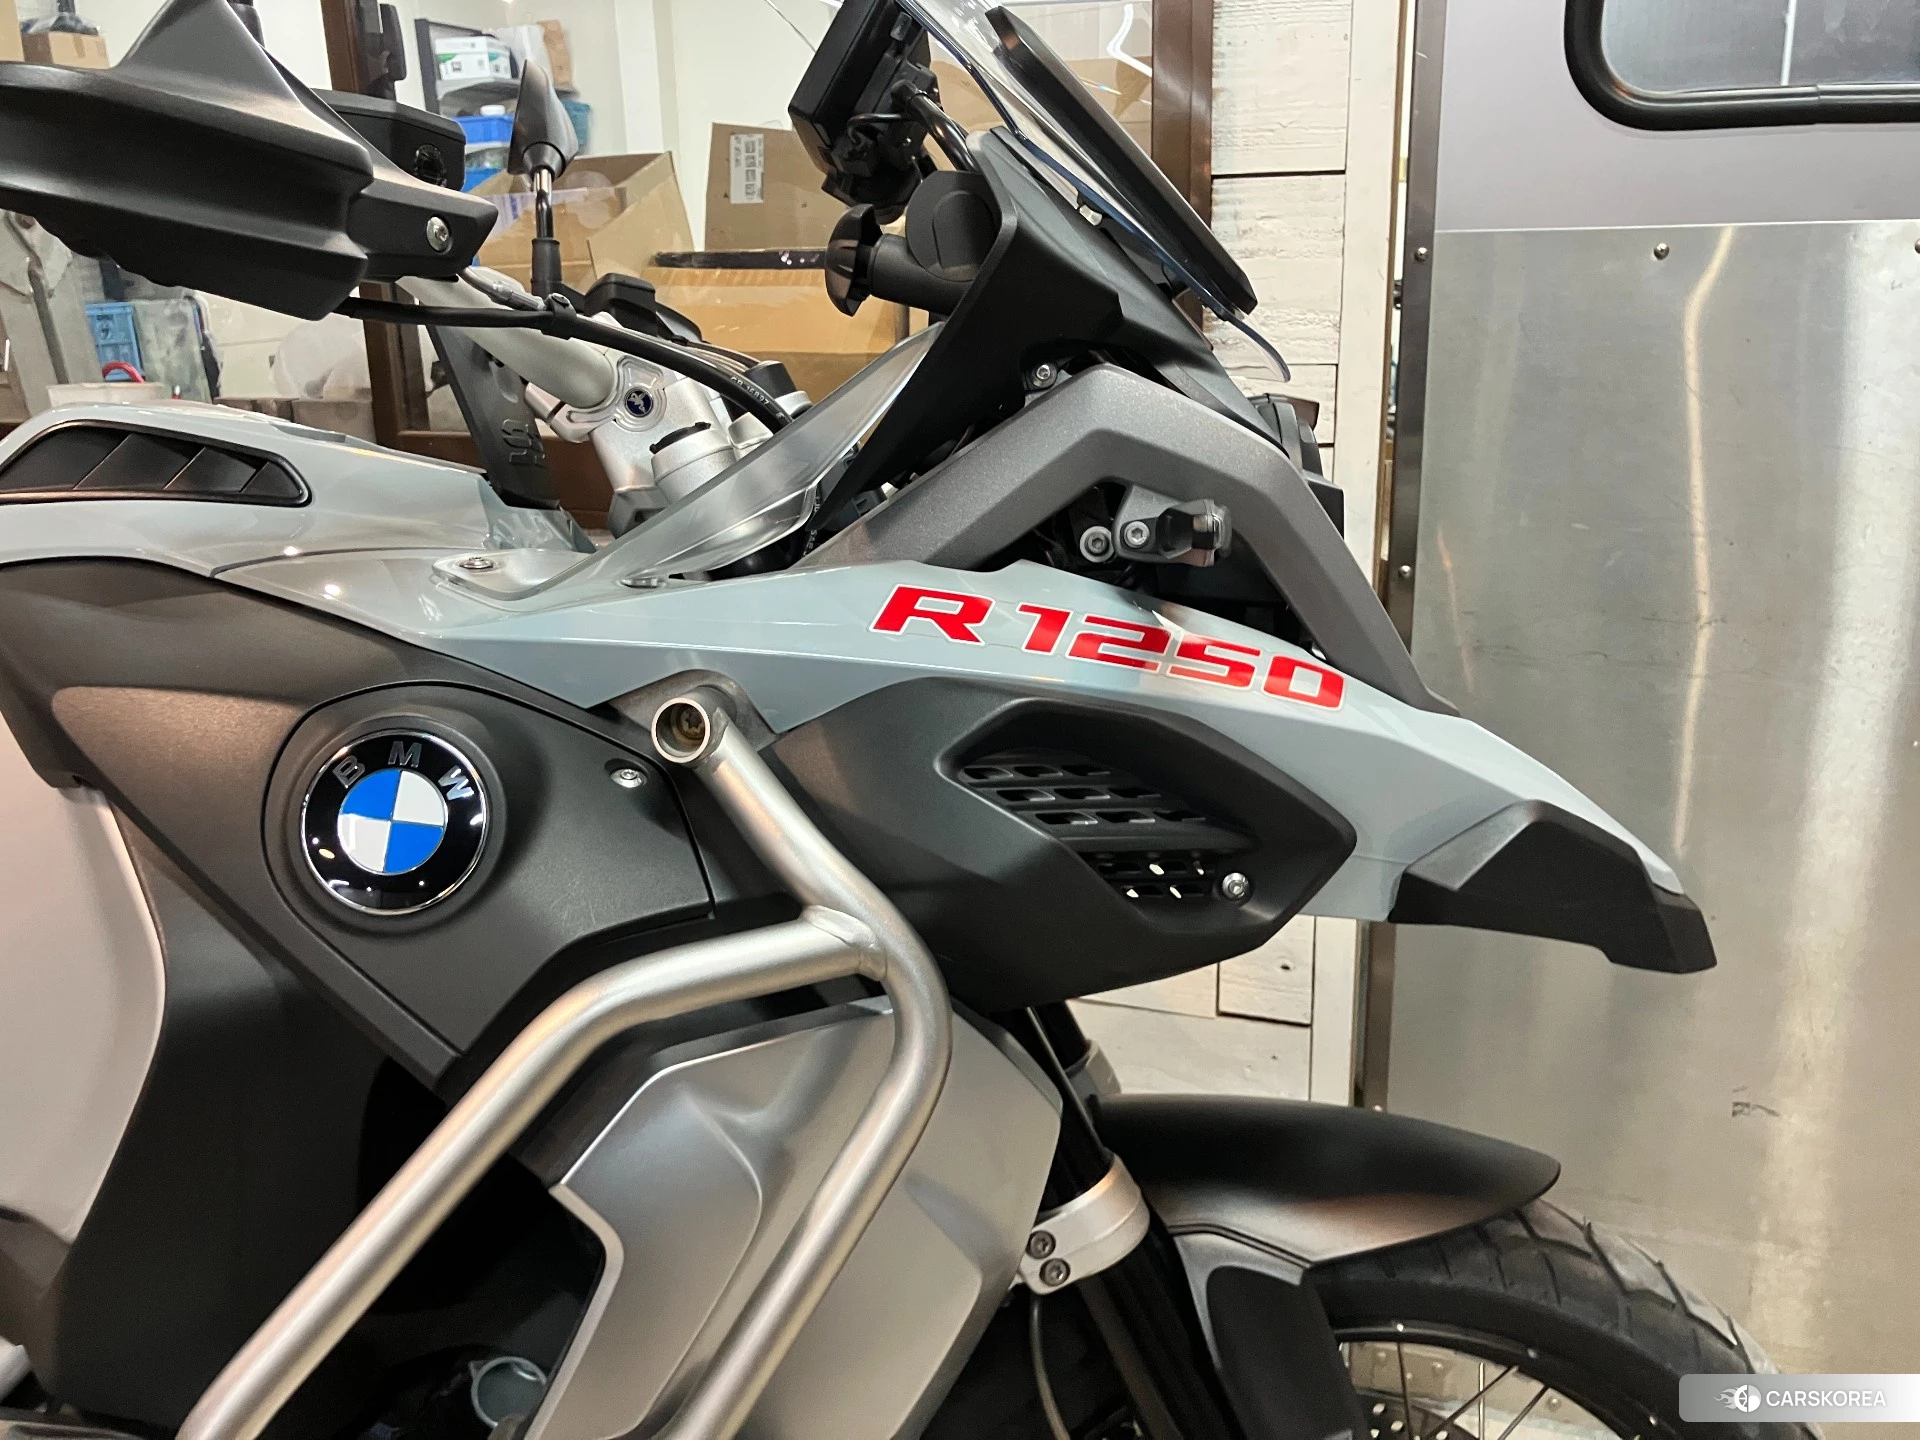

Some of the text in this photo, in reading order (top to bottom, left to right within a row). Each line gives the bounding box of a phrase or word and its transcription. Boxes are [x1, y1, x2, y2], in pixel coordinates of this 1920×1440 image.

[867, 584, 1348, 711] R 1250
[332, 740, 475, 801] BMW
